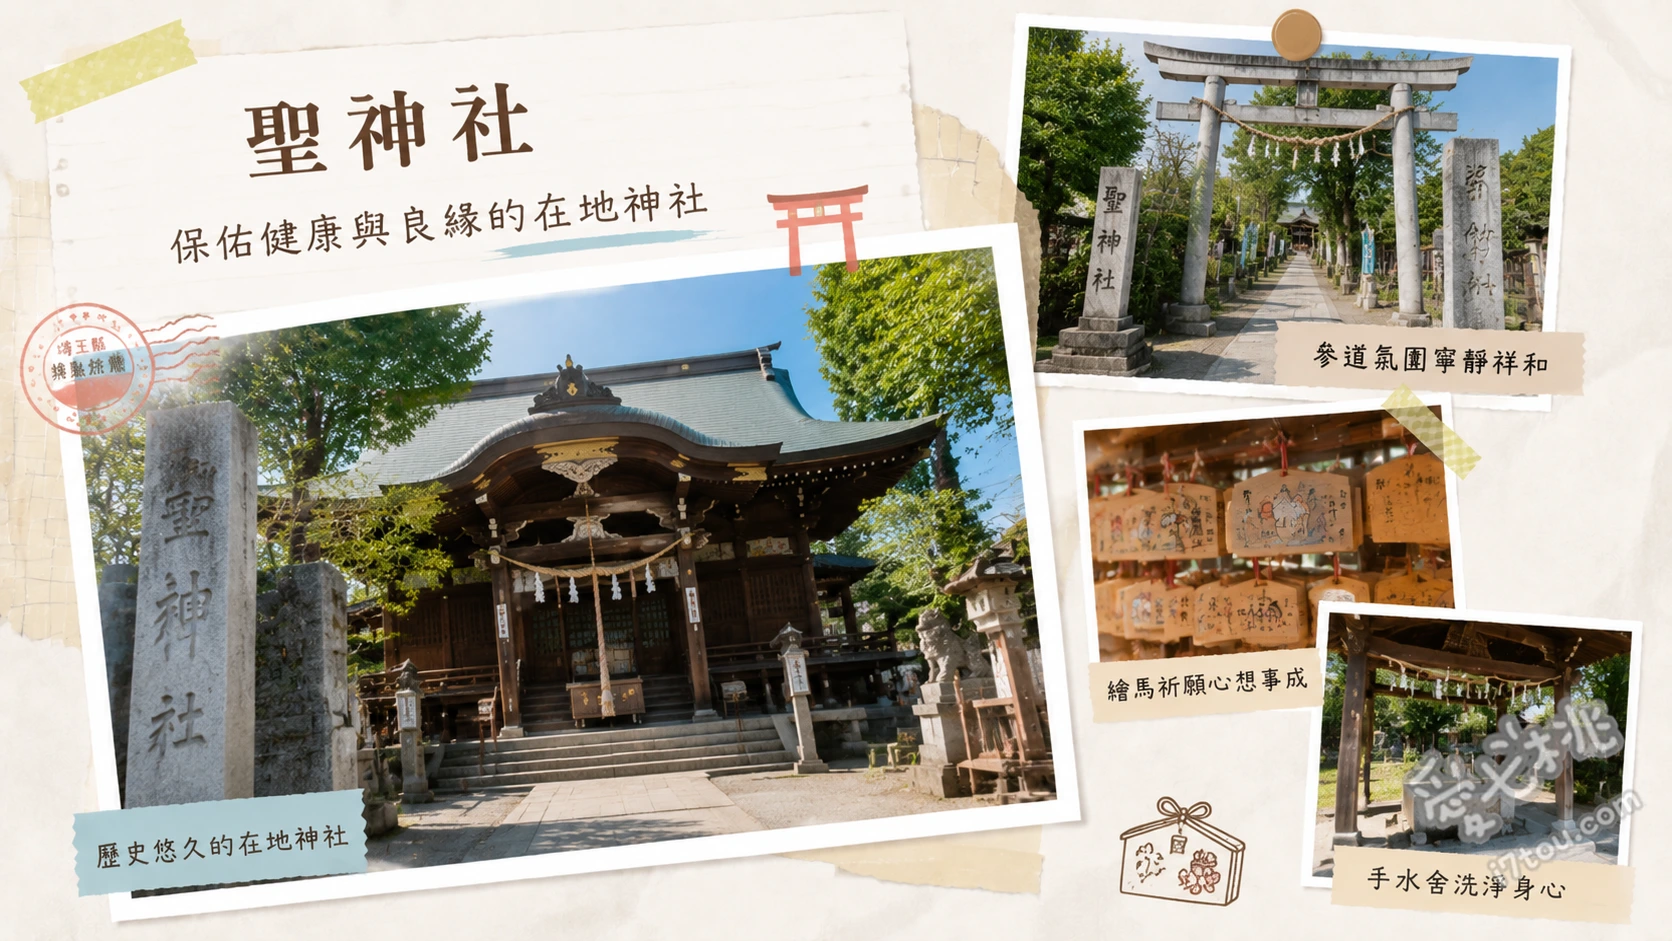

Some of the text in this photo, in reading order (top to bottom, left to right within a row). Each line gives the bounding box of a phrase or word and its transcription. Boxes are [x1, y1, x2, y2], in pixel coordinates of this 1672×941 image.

[1092, 186, 1127, 294] 聖神社
[149, 490, 216, 762] 聖神社
